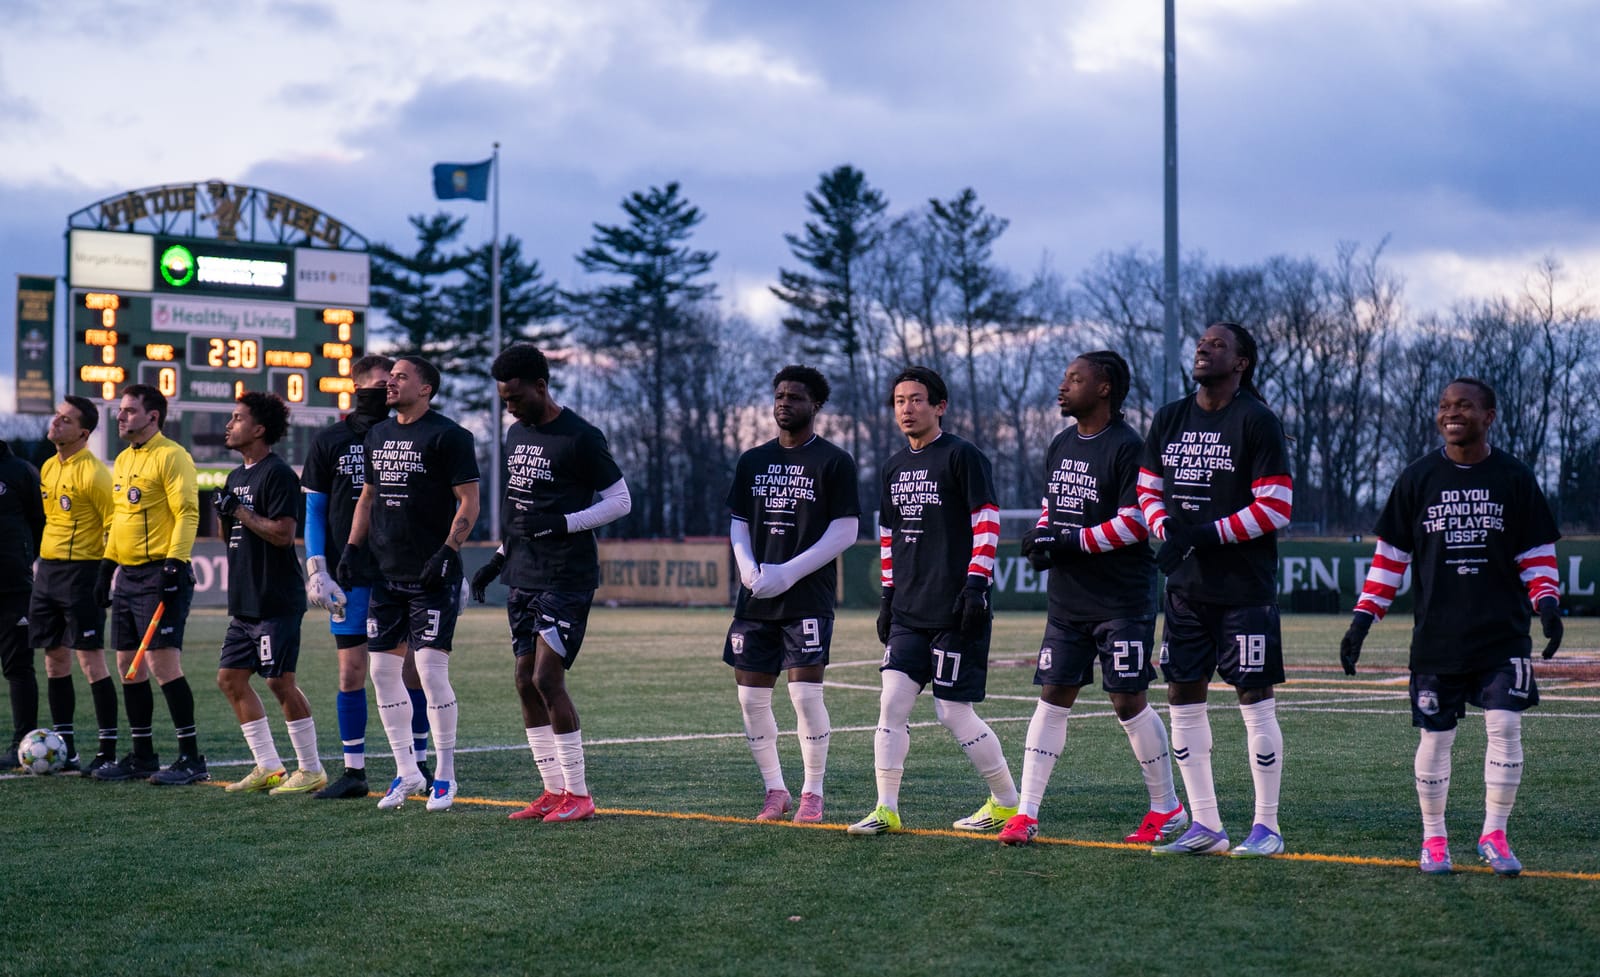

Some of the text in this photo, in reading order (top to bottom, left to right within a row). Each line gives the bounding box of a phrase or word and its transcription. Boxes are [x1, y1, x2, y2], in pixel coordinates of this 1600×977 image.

[100, 186, 196, 228] VIRTUE
[266, 193, 342, 248] FIELD
[300, 271, 328, 282] BEST
[172, 306, 292, 336] Healthy Living
[159, 368, 176, 396] 0
[287, 374, 304, 402] 0
[383, 440, 413, 450] DO YOU
[1182, 432, 1221, 444] DO YOU
[372, 450, 421, 462] STAND WITH
[514, 445, 544, 456] DO YOU
[1166, 444, 1230, 457] STAND WITH
[339, 454, 364, 464] STAN
[527, 456, 550, 469] WITH
[1061, 459, 1089, 473] DO YOU
[1161, 455, 1235, 472] THE PLAYERS,
[383, 461, 427, 474] PLAYERS,
[768, 464, 804, 475] DO YOU
[1174, 468, 1212, 481] USSF?
[380, 472, 408, 482] USSF?
[755, 475, 814, 488] STAND WITH
[899, 470, 928, 481] DO YOU
[1052, 471, 1096, 488] STAND WITH
[751, 486, 816, 502] THE PLAYERS,
[891, 482, 937, 494] STAND WITH
[1062, 484, 1099, 503] PLAYERS,
[900, 493, 942, 506] PLAYERS,
[1056, 496, 1084, 510] USSF?
[1442, 489, 1489, 503] DO YOU
[765, 498, 796, 509] USSF?
[1428, 502, 1503, 518] STAND WITH
[1423, 516, 1504, 533] THE PLAYERS,
[1445, 530, 1487, 543] USSF?
[666, 561, 718, 587] FIELD
[425, 610, 441, 636] 3
[802, 618, 820, 646] 9
[261, 635, 272, 661] 8
[1236, 634, 1266, 666] 18
[1113, 641, 1144, 671] 27
[933, 648, 961, 680] 17
[1510, 657, 1531, 691] 11
